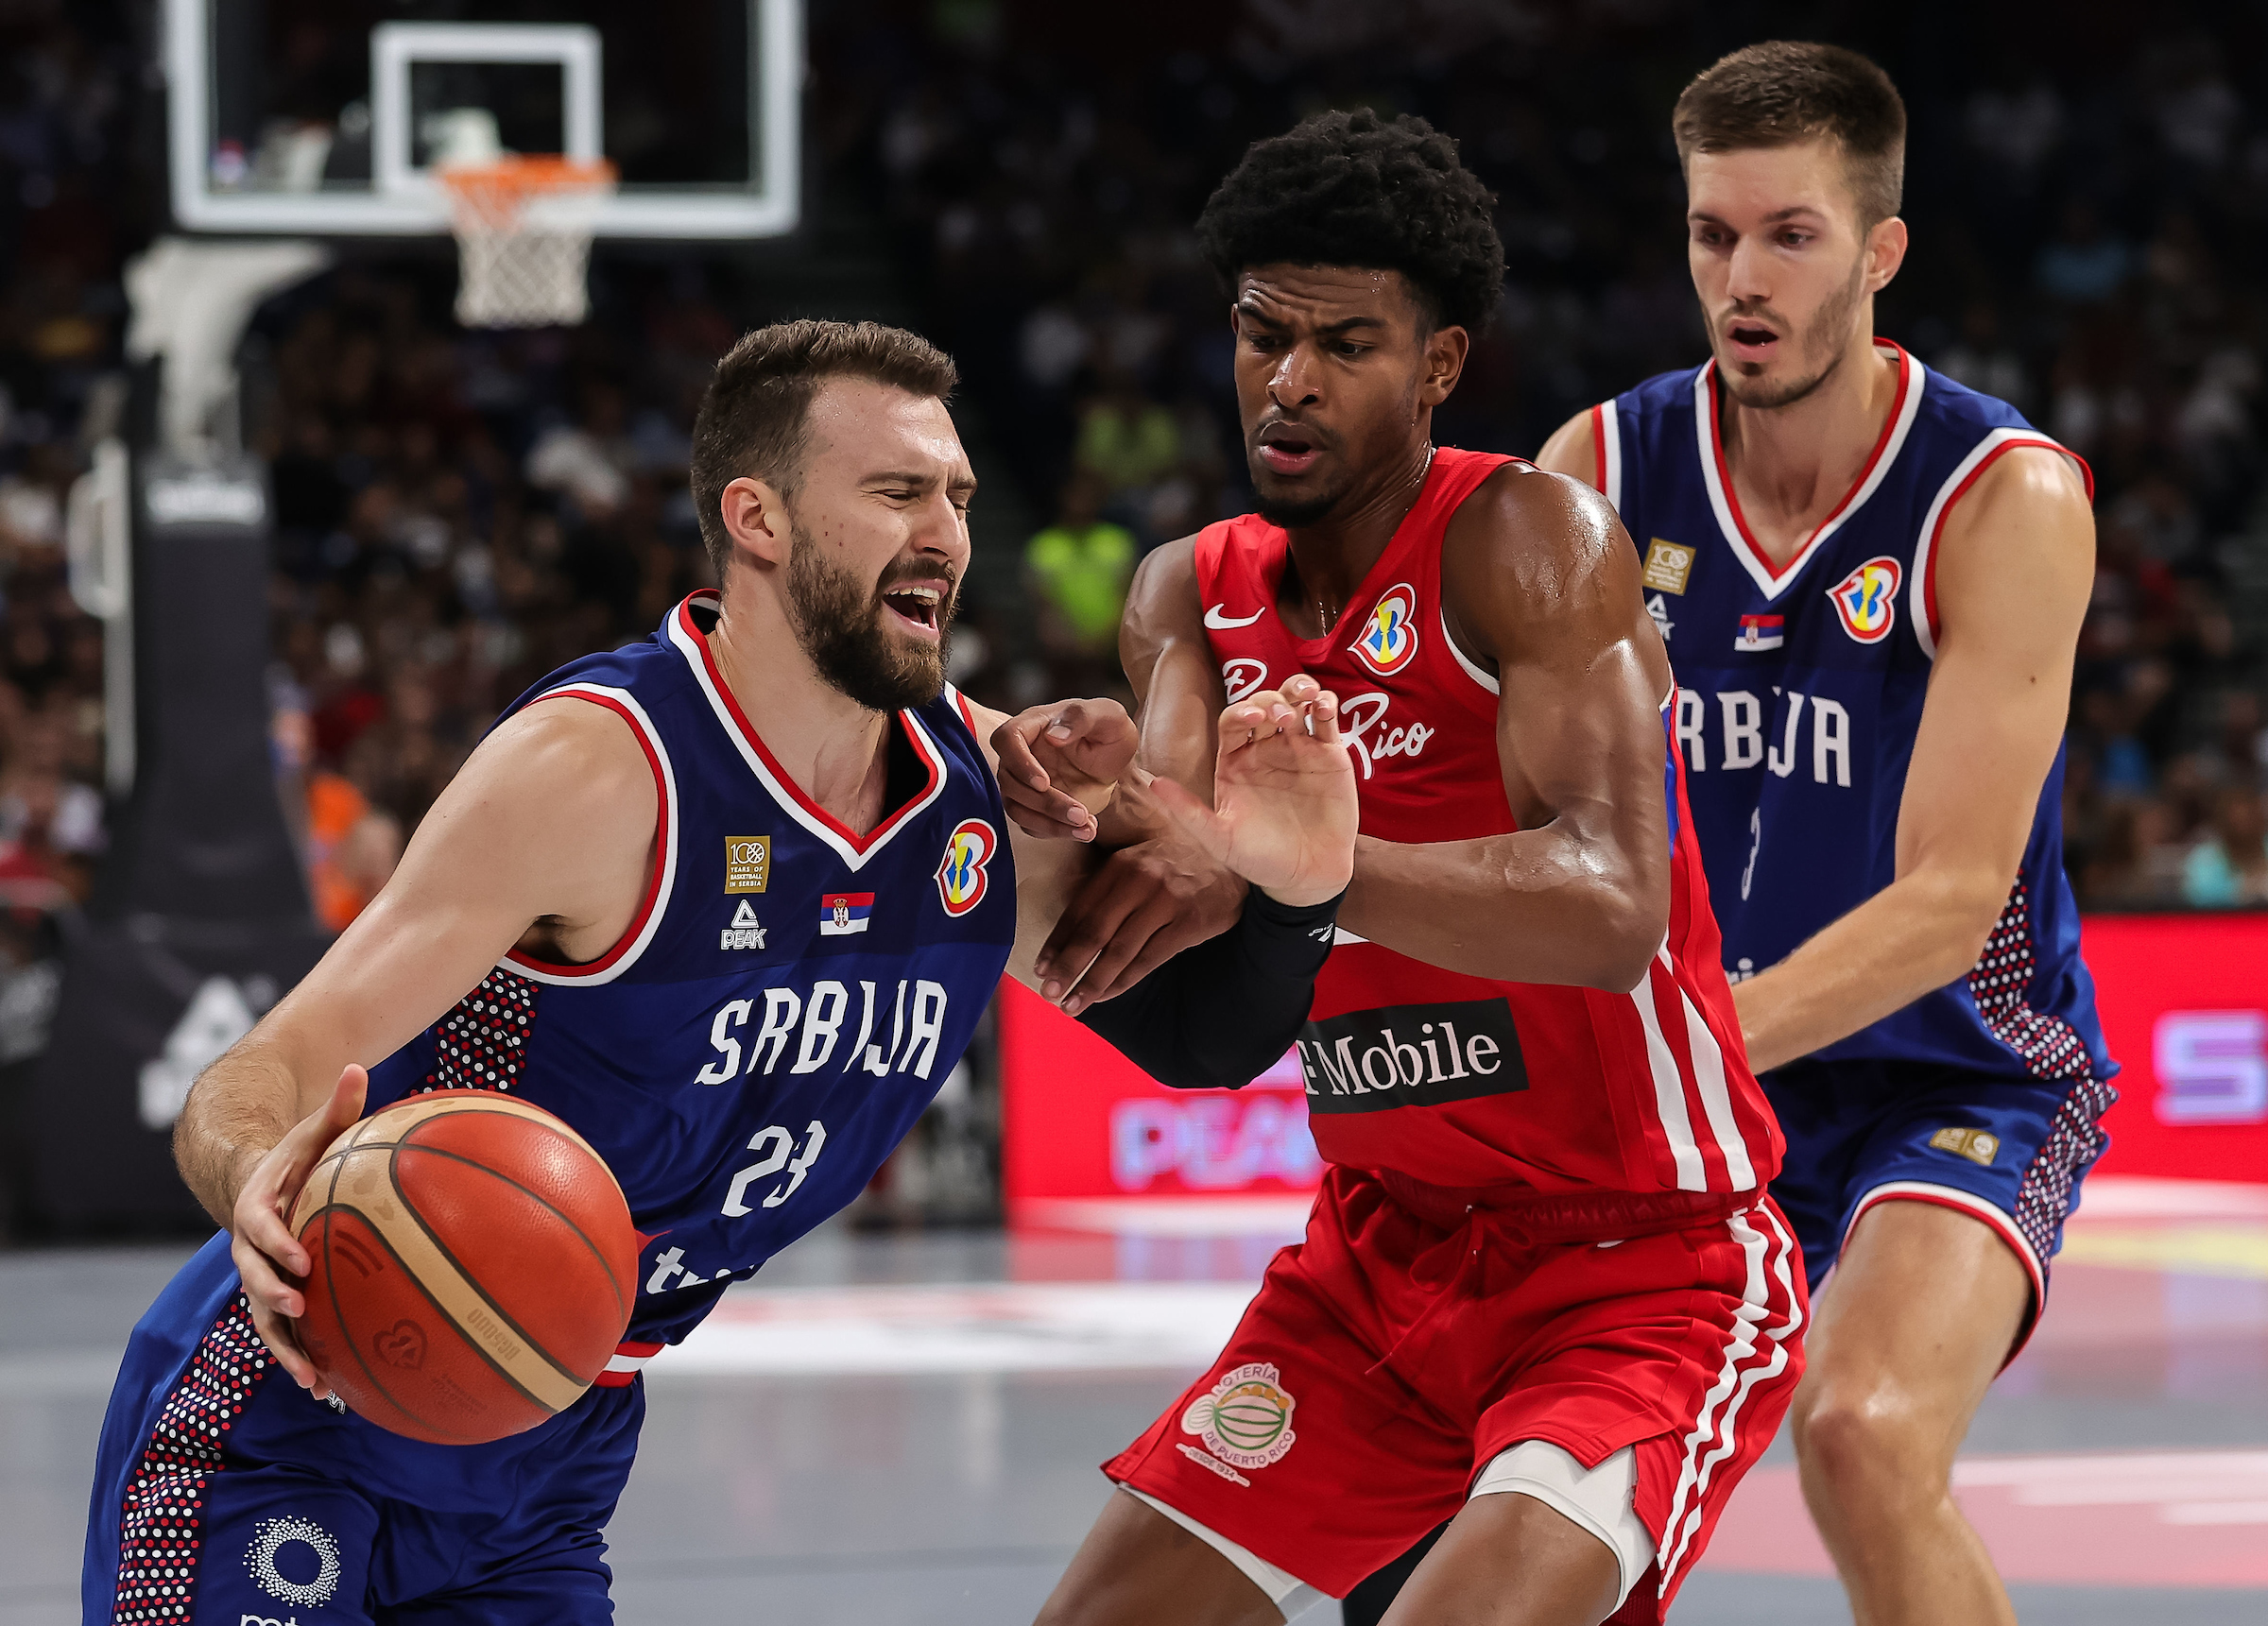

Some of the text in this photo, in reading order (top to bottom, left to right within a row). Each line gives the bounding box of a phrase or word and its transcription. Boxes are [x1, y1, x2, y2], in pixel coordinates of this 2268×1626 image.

[1338, 692, 1435, 780] Rico
[1676, 685, 1851, 788] RBJA
[730, 842, 765, 864] 100
[721, 929, 767, 950] PEAK
[694, 979, 948, 1086] SRBIJA
[721, 1120, 827, 1218] 23
[1214, 1364, 1277, 1395] LOTERÍA
[1205, 1431, 1293, 1465] DE PUERTO RICO
